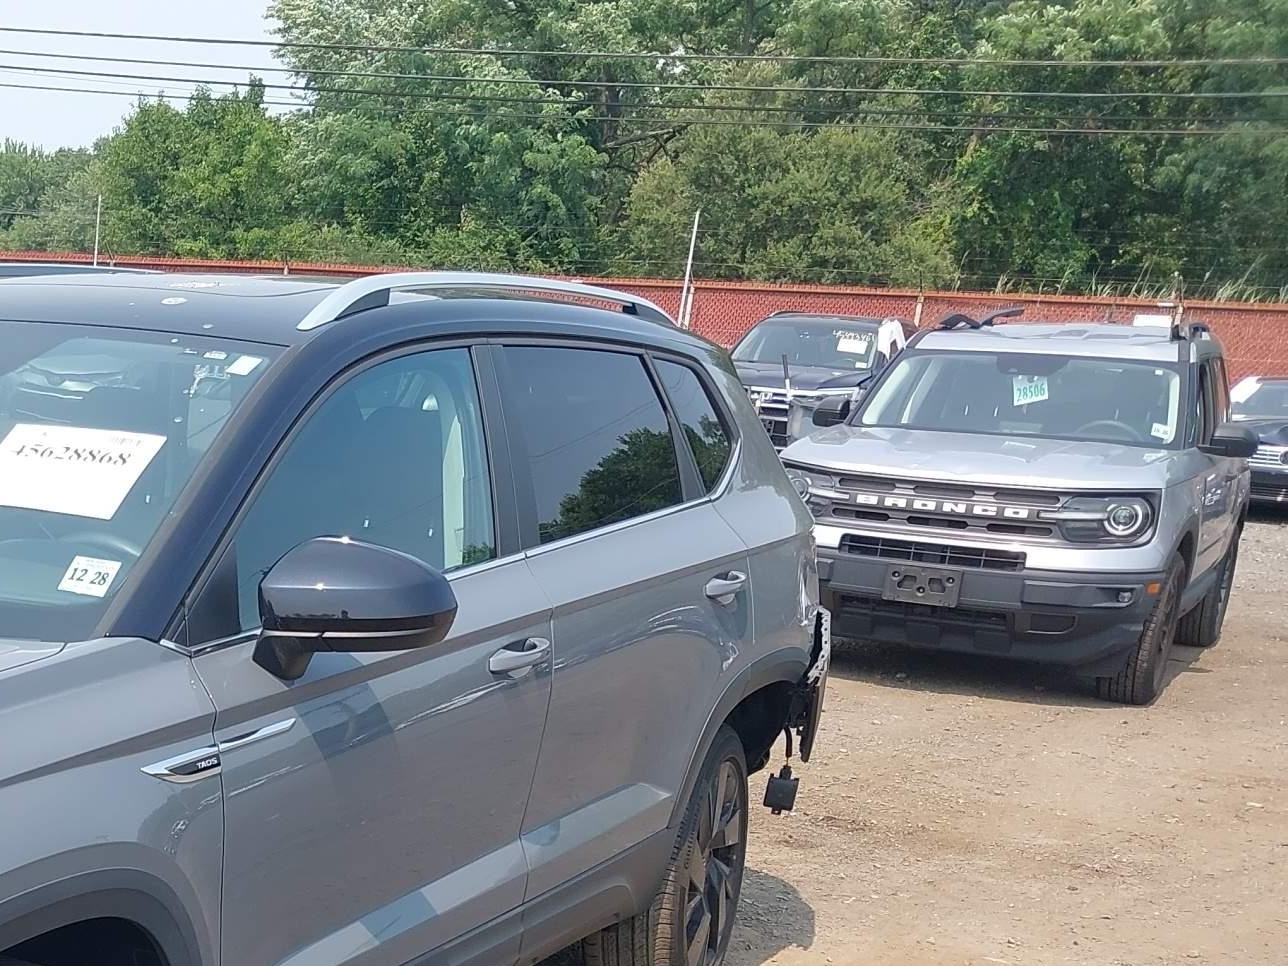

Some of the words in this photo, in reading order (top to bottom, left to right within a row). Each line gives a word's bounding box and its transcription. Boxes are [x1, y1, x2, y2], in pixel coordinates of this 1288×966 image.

[1015, 383, 1046, 402] 28506
[13, 444, 132, 465] 45628868
[856, 494, 1029, 518] BRONCO
[68, 567, 89, 582] 12
[88, 571, 110, 586] 28
[196, 757, 218, 769] TAOS
